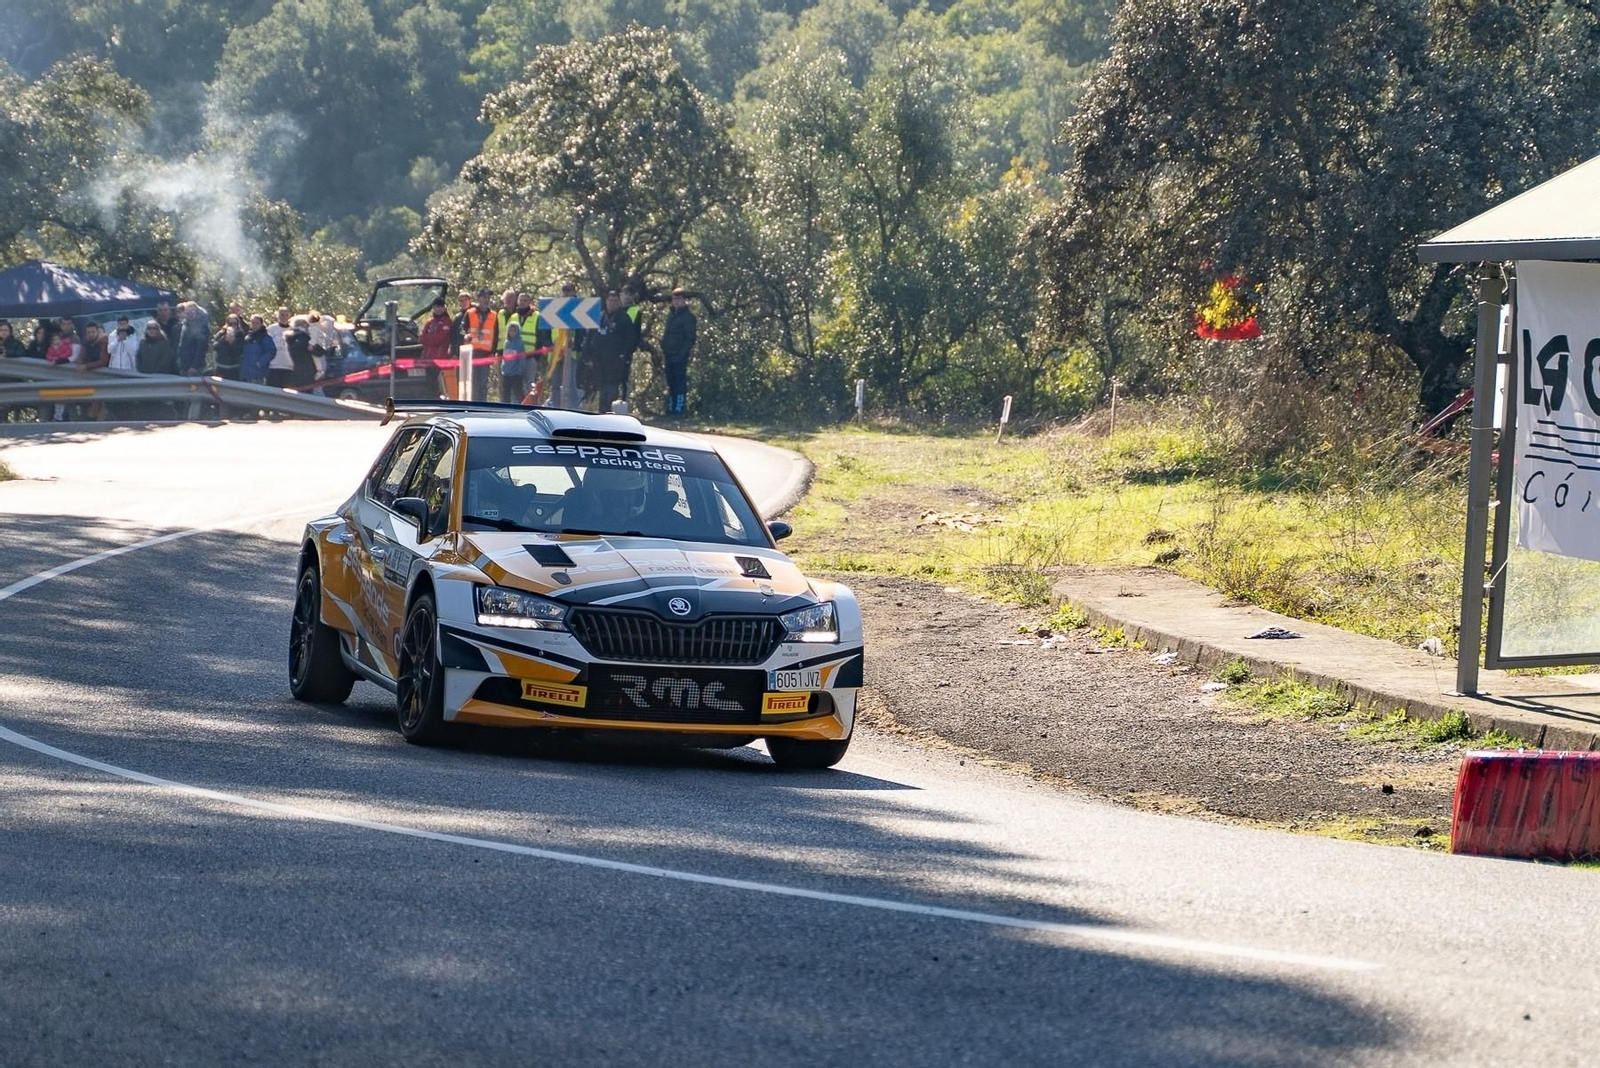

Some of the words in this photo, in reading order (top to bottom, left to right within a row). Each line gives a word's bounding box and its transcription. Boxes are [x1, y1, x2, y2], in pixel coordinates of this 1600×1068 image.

[1522, 328, 1571, 417] LA
[511, 444, 686, 464] sespande
[592, 457, 642, 469] racing
[645, 460, 687, 473] team
[776, 672, 803, 688] 6051
[804, 671, 820, 687] JVZ
[526, 683, 579, 702] PIRELLI
[767, 696, 806, 710] PIRELLI
